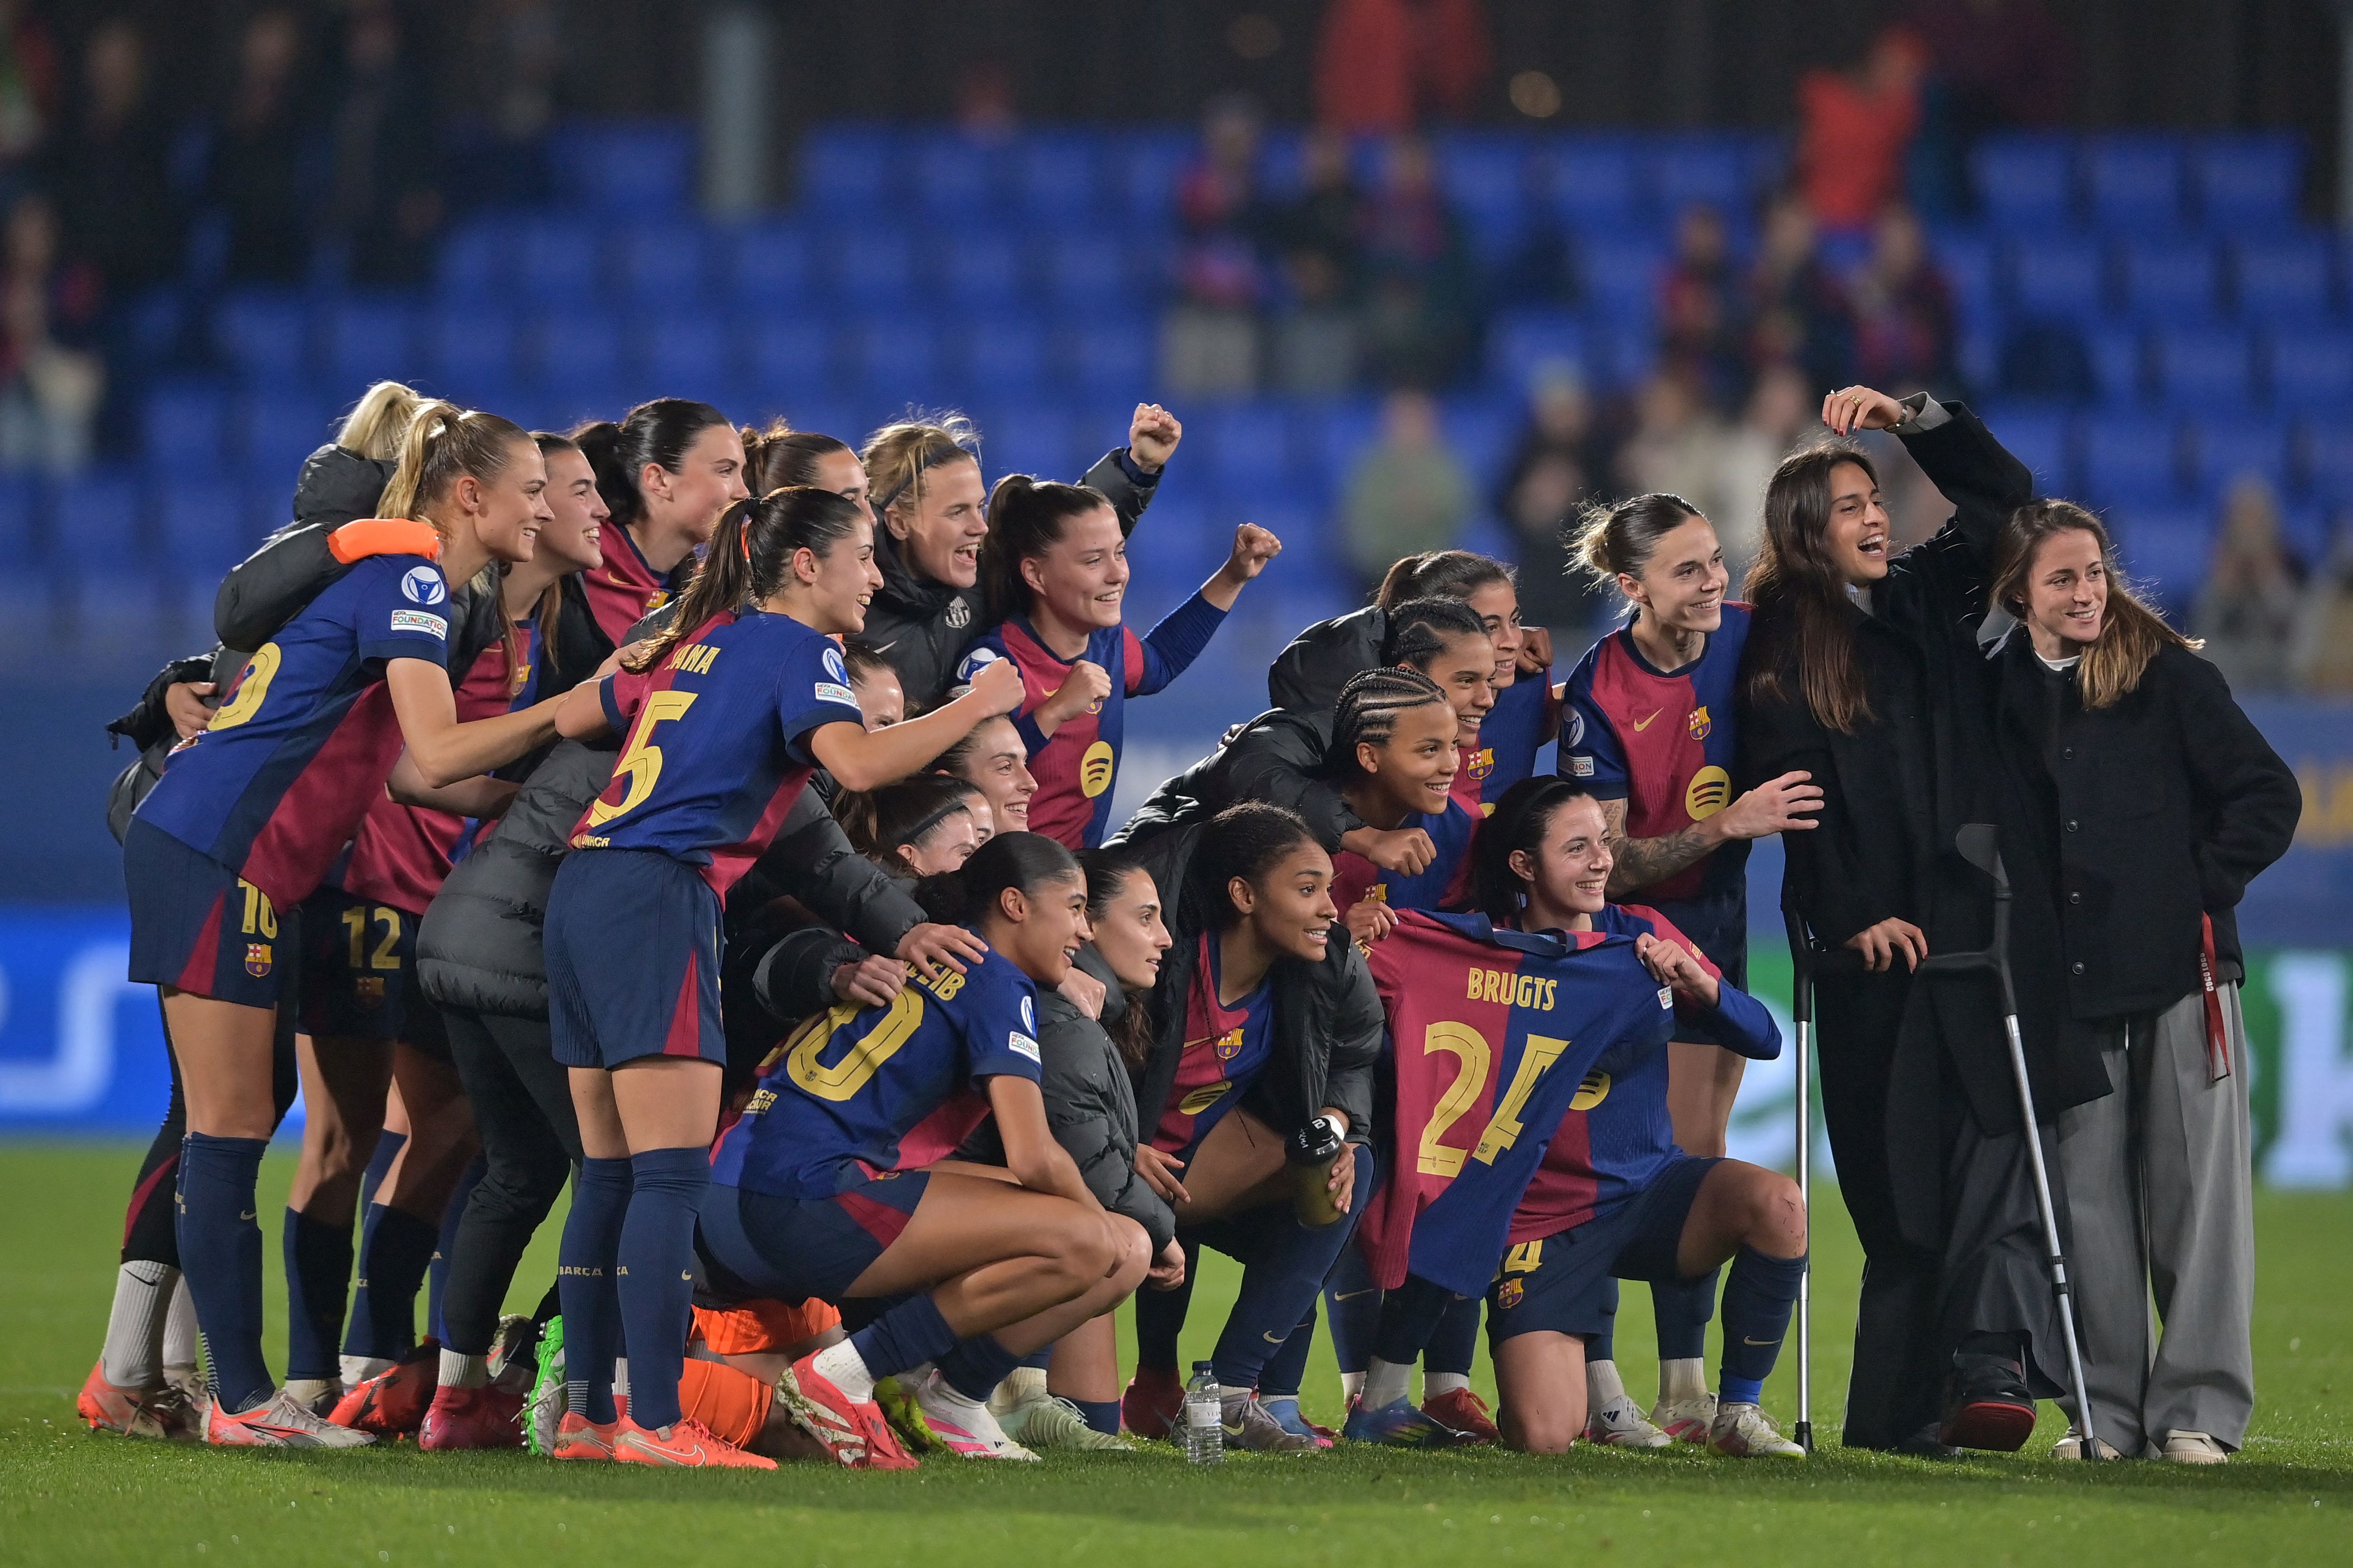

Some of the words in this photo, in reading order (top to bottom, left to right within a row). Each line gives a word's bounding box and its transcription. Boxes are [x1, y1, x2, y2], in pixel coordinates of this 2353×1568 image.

[393, 616, 446, 634] FOUNDATION
[585, 690, 698, 828] 5
[342, 906, 401, 969] 12
[2200, 953, 2209, 971] LOCO
[1466, 966, 1558, 1012] BRUGTS
[2203, 971, 2214, 992] COCO
[1416, 1020, 1572, 1178] 24
[559, 1265, 603, 1277] BARÇA
